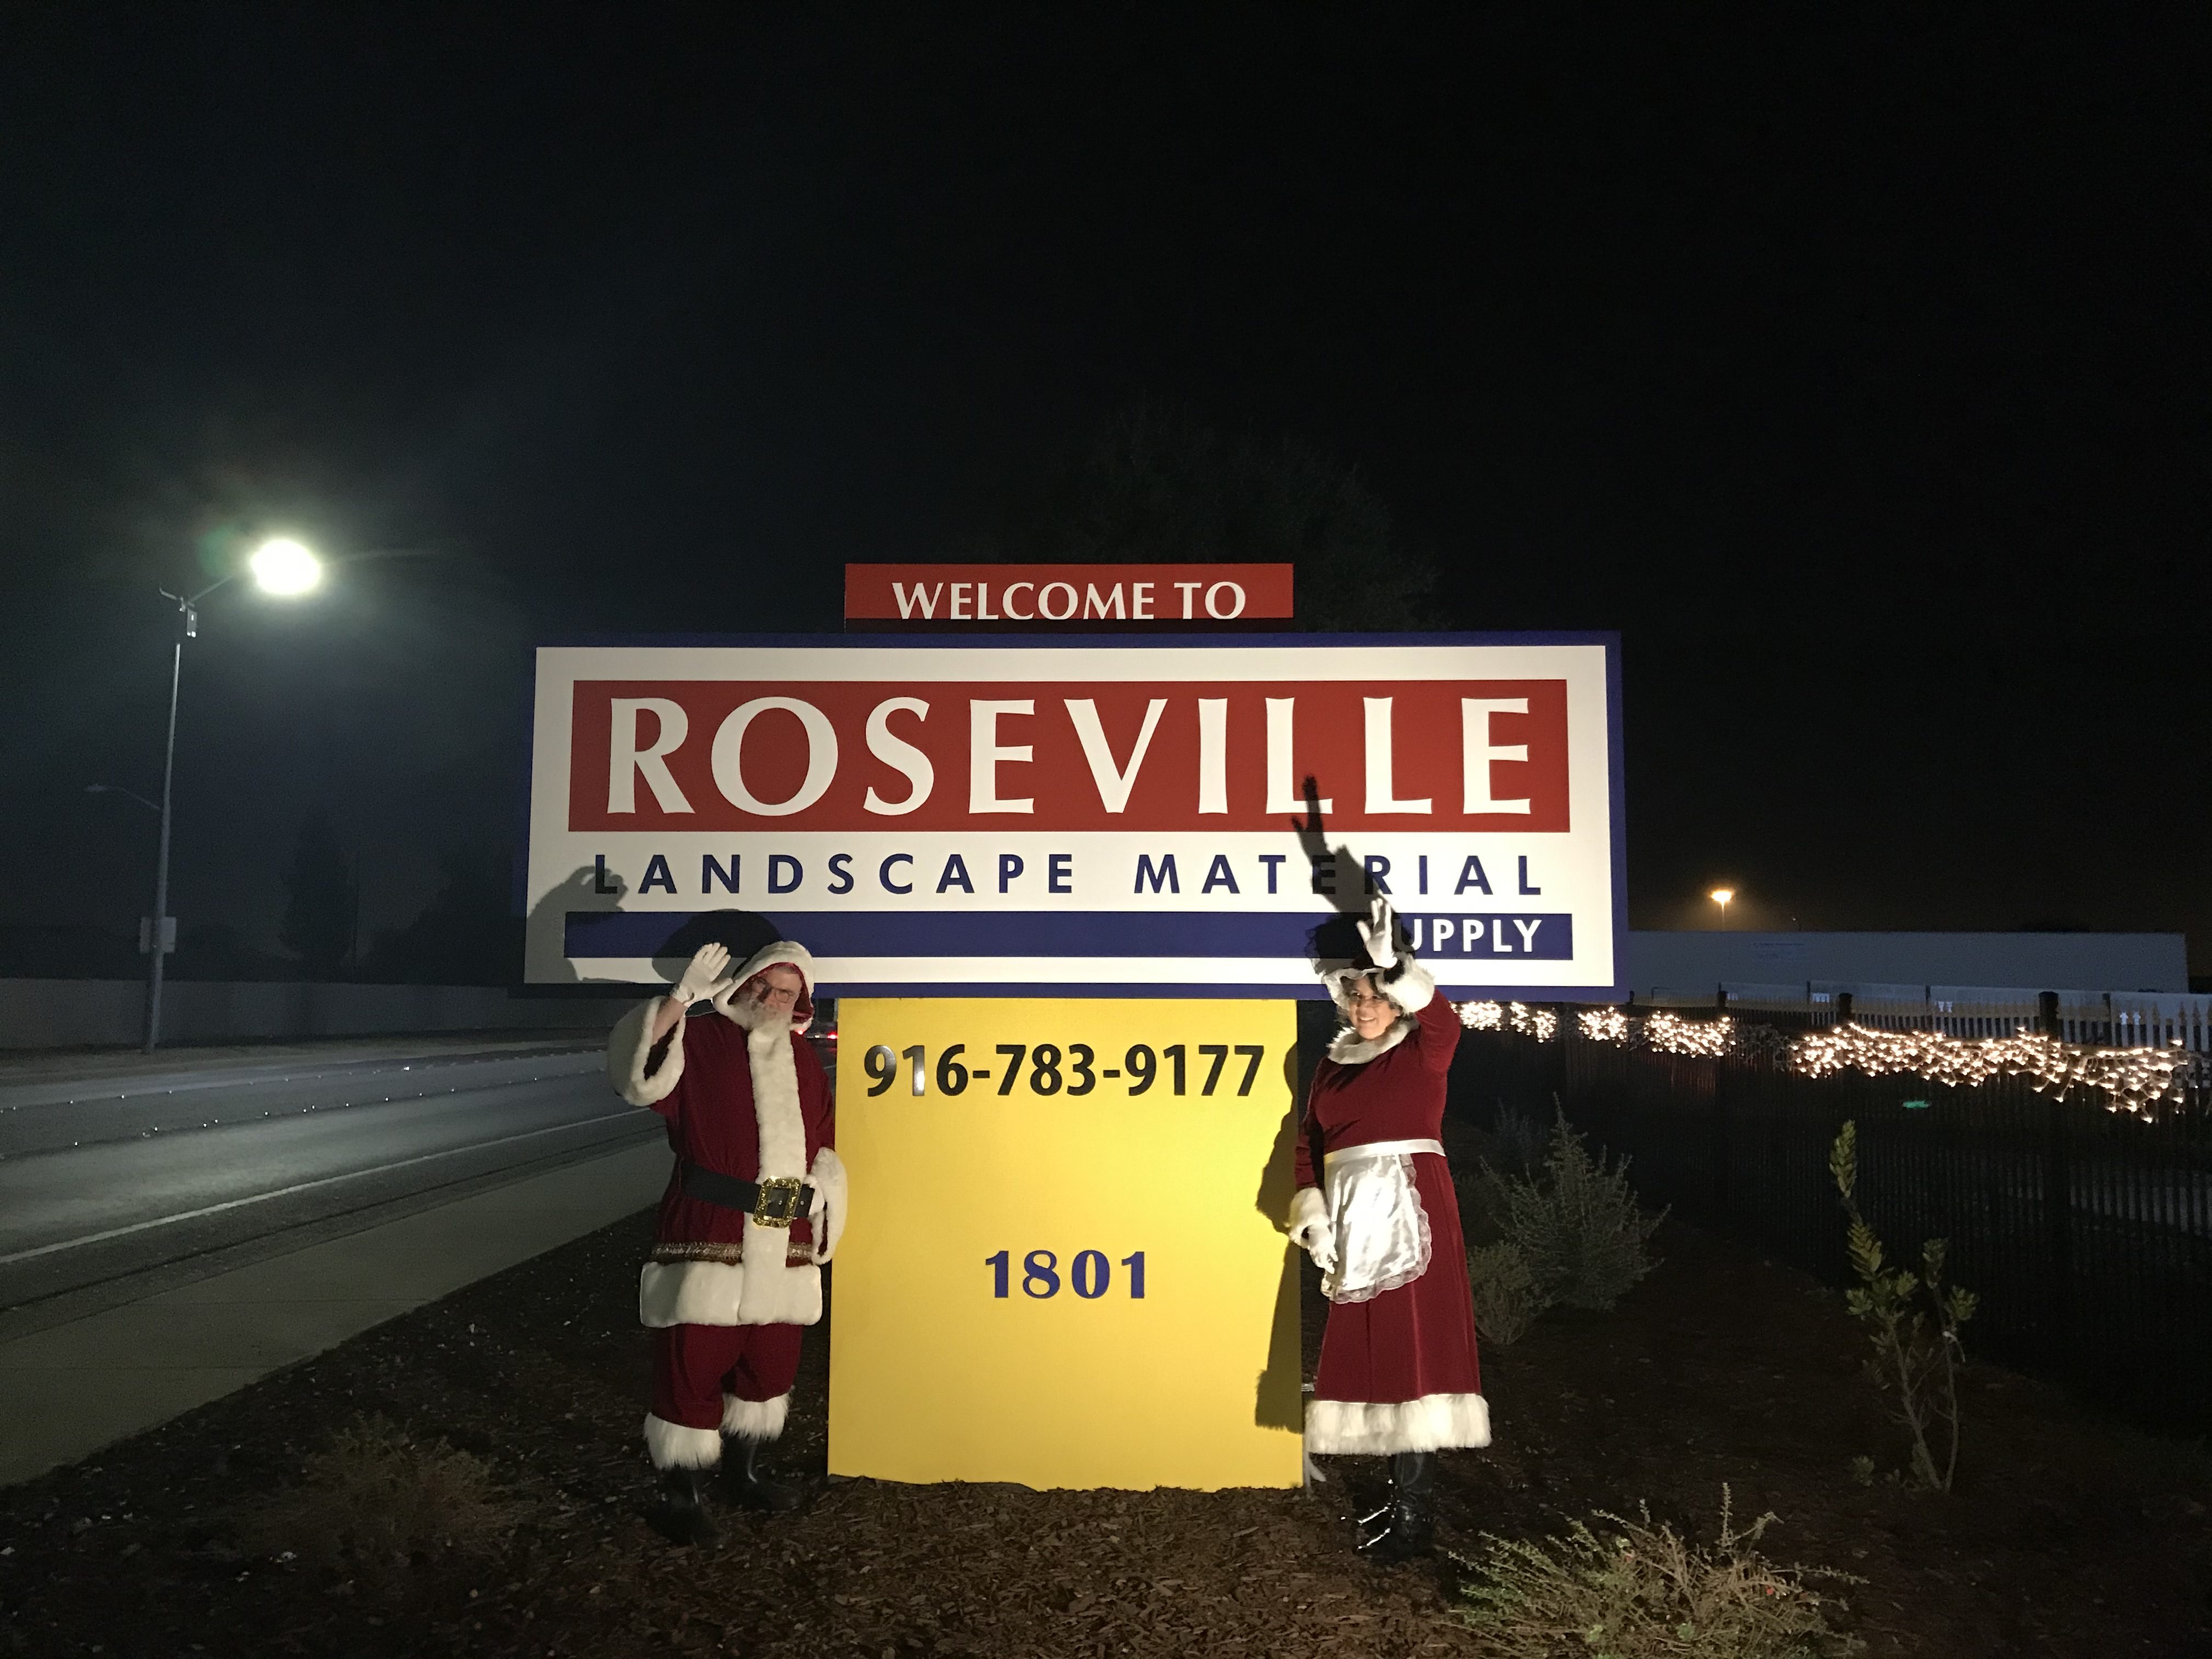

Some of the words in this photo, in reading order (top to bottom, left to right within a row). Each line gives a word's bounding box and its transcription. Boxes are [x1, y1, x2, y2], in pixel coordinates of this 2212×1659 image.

[891, 582, 1154, 620] WELCOME
[1174, 582, 1246, 620] TO
[607, 696, 1531, 816] ROSEVILLE
[595, 854, 1072, 894] LANDSCAPE
[1133, 854, 1541, 895] MATERIAL
[1366, 918, 1542, 952] UPPLY
[864, 1043, 1264, 1097] 916-783-9177
[985, 1250, 1146, 1299] 1801
